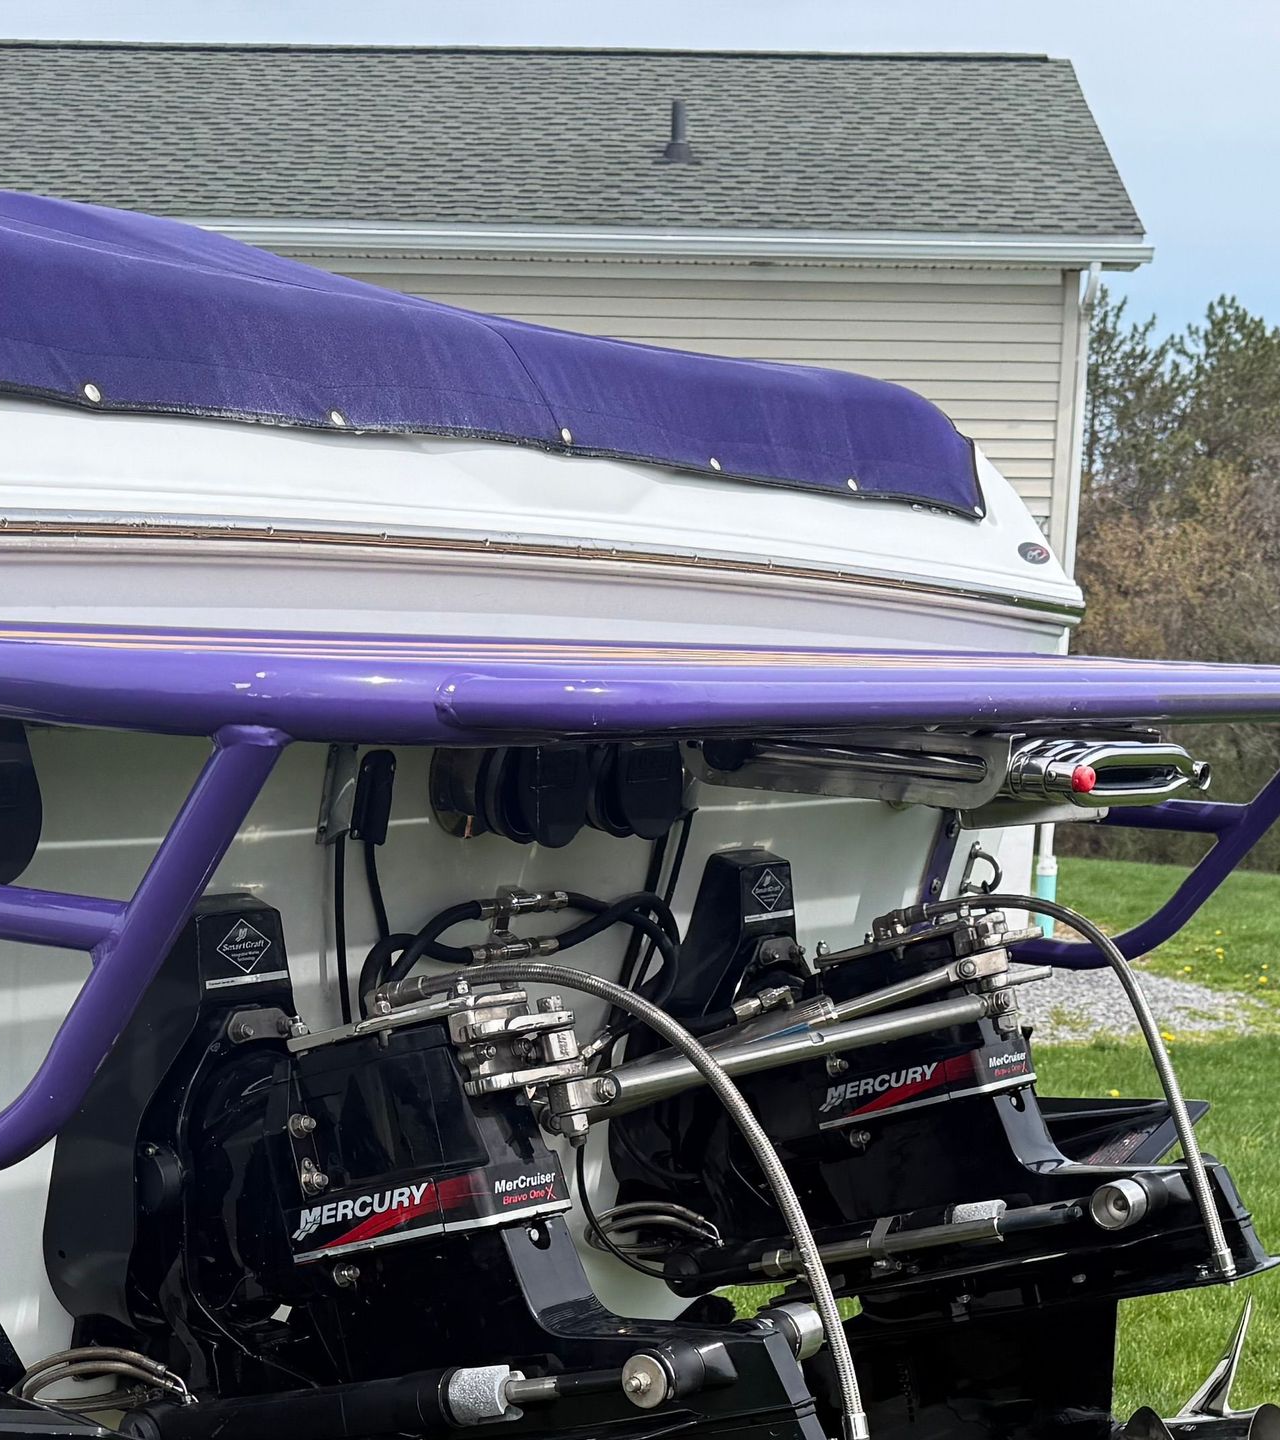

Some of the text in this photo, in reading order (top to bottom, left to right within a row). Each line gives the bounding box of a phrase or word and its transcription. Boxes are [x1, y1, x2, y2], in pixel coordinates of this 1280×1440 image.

[989, 1051, 1026, 1067] MerCruiser
[819, 1062, 937, 1112] MERCURY
[495, 1172, 556, 1193] MerCruiser
[503, 1193, 528, 1205] Bravo
[530, 1189, 545, 1198] One
[292, 1183, 428, 1241] MERCURY
